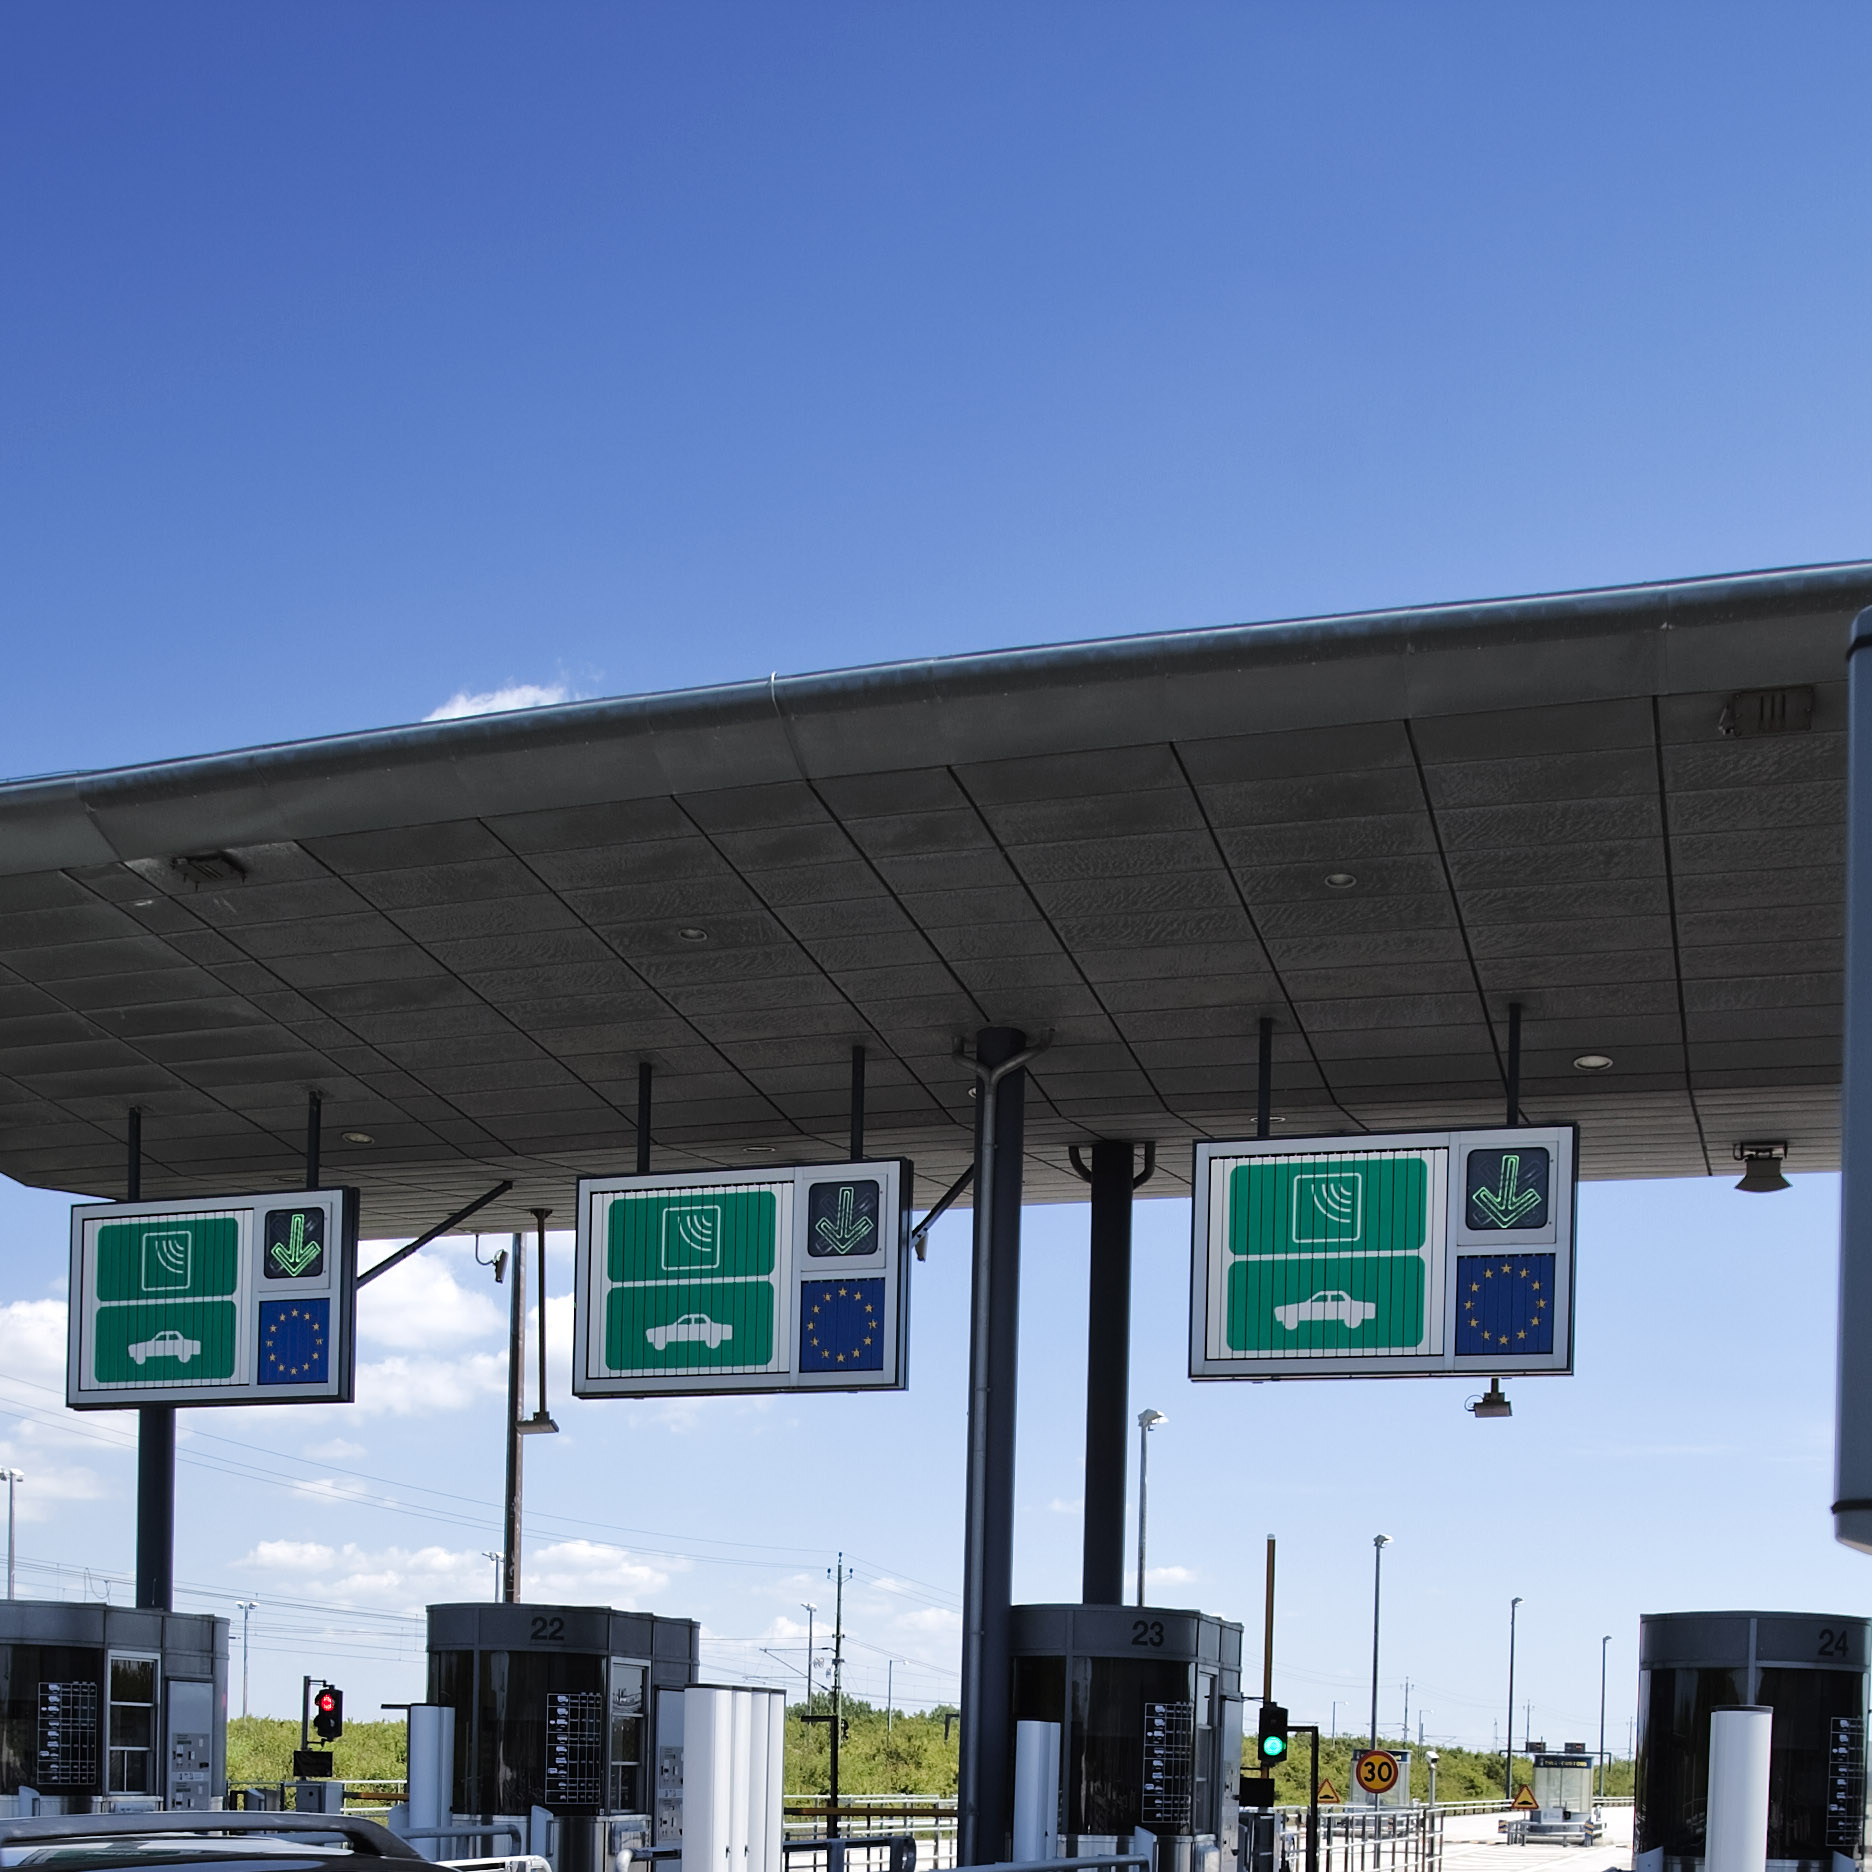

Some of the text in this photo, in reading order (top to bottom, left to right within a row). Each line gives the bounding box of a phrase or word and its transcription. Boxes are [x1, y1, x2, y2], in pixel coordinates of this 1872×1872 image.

[530, 1616, 565, 1641] 22
[1131, 1620, 1165, 1647] 23
[1818, 1629, 1849, 1657] 24
[1364, 1761, 1392, 1782] 30
